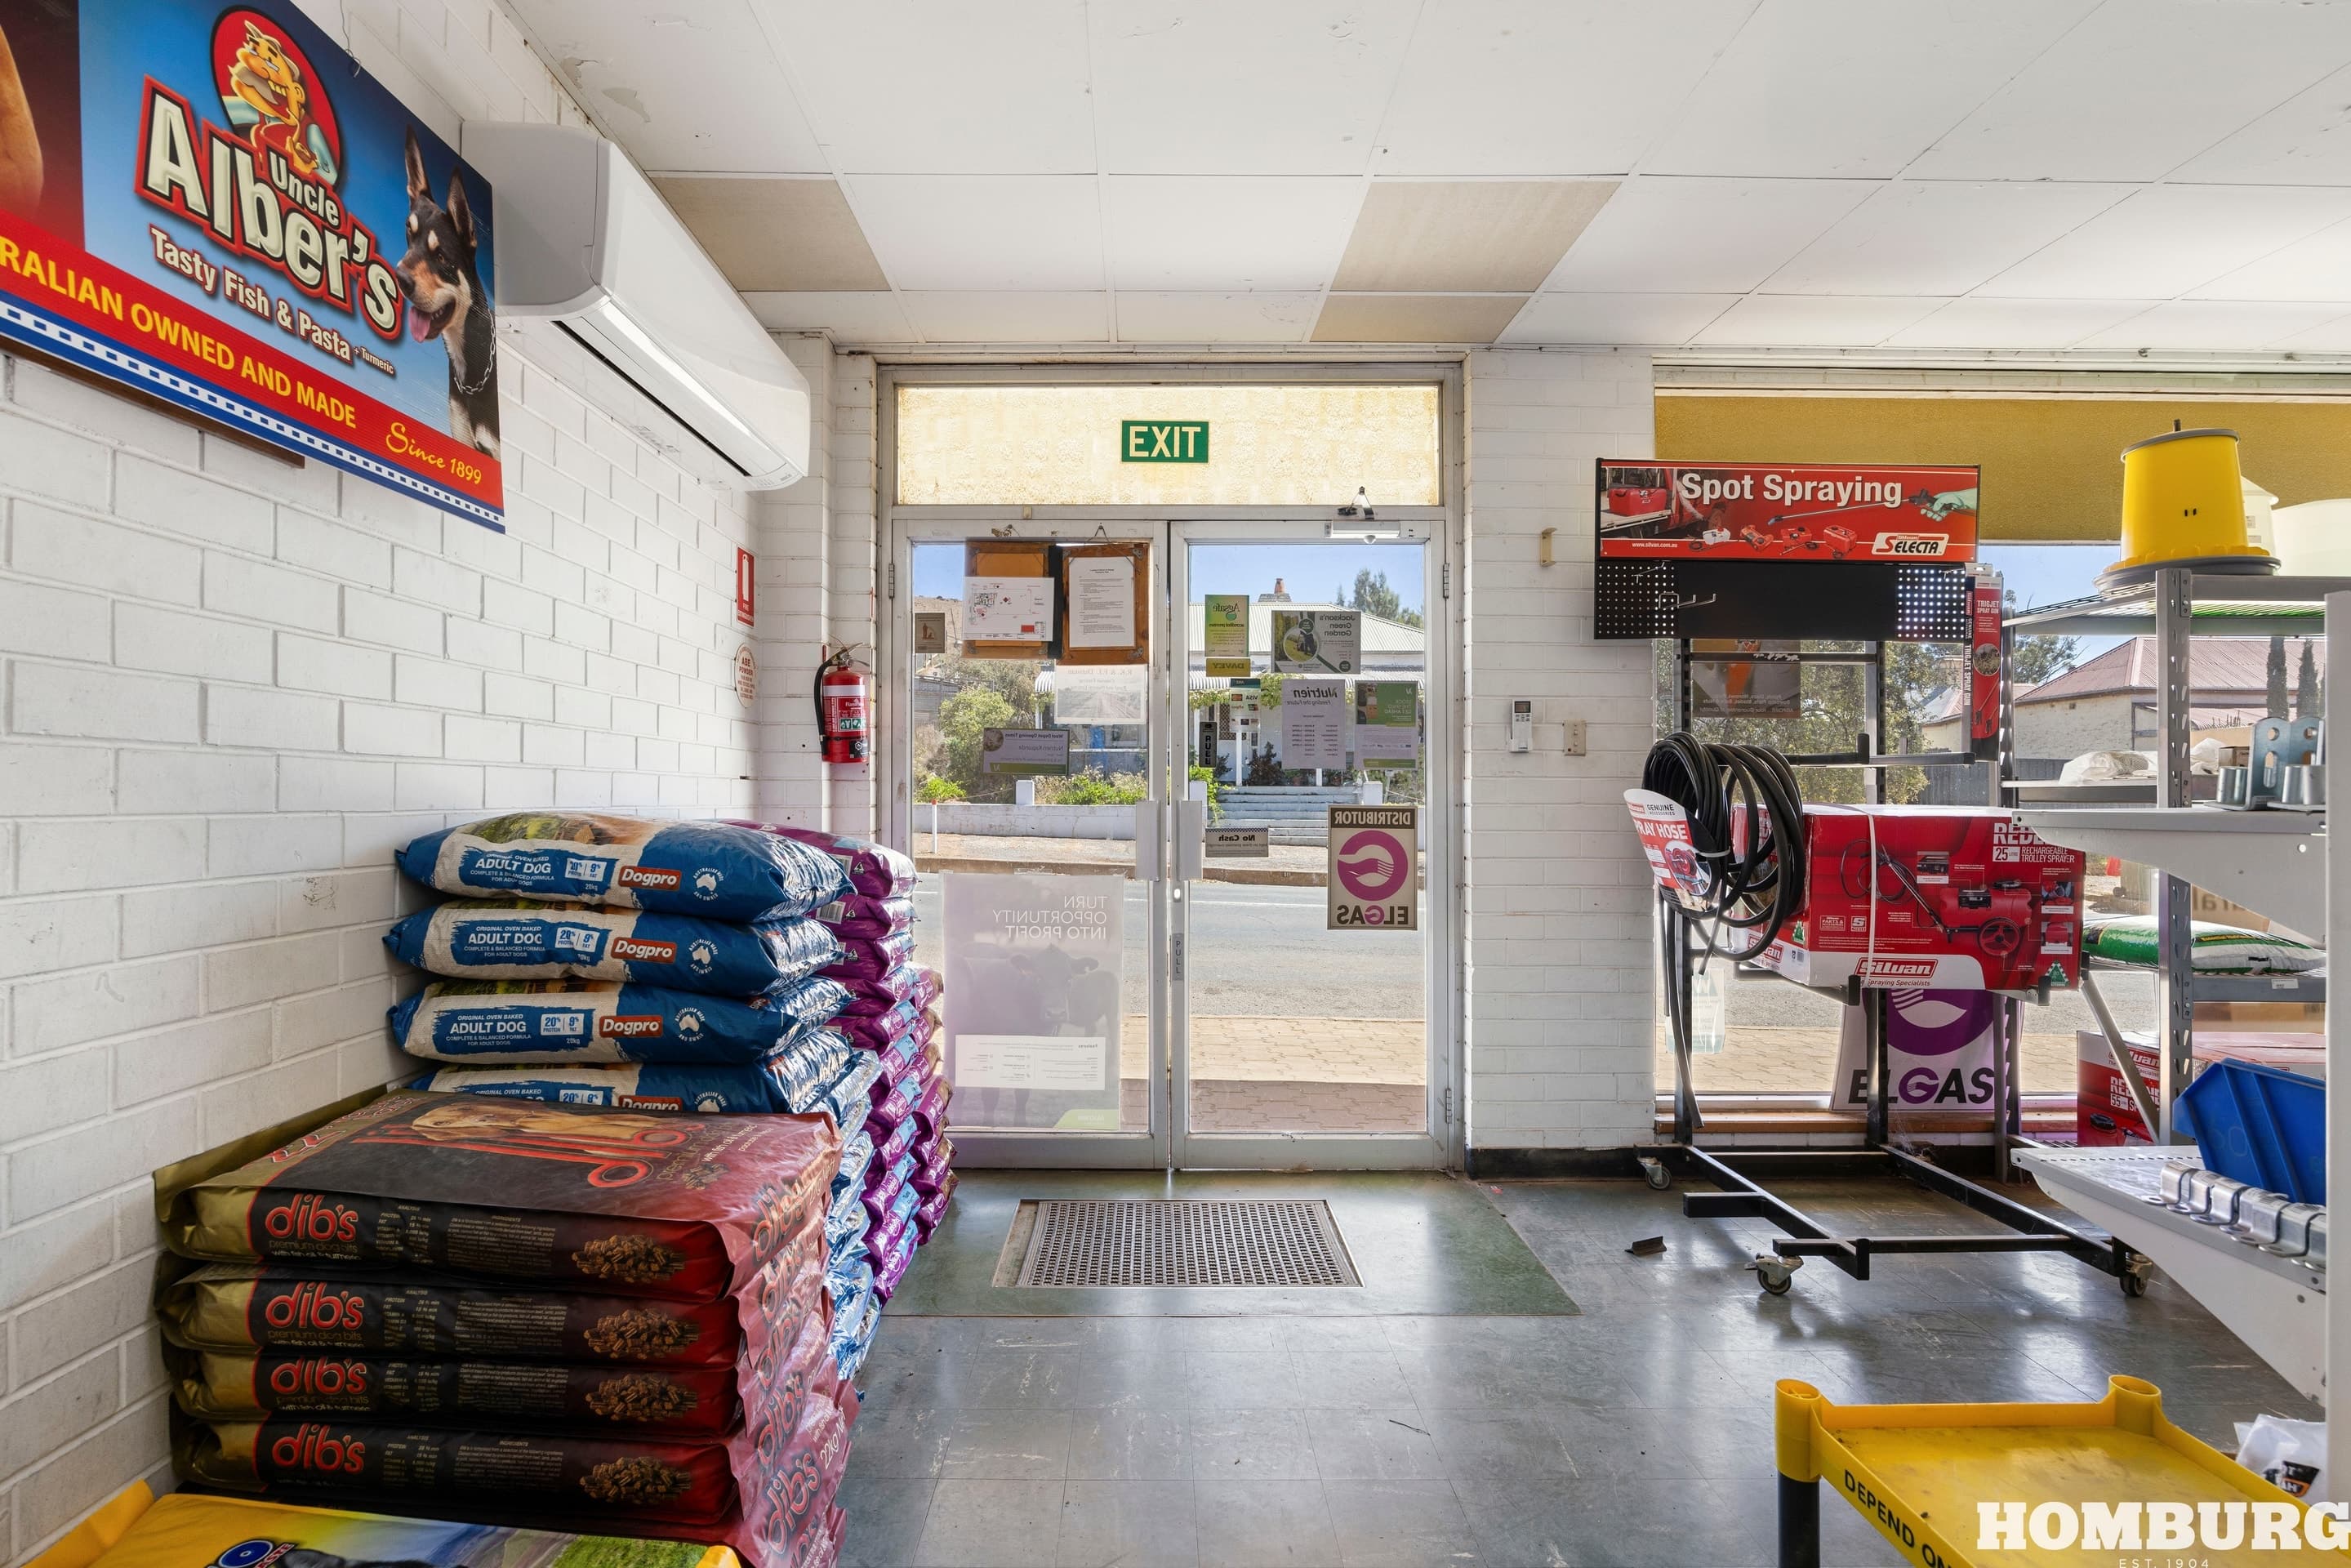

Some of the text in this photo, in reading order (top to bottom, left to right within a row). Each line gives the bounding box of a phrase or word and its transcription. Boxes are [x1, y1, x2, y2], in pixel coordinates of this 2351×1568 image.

[270, 149, 341, 226] Uncle
[145, 91, 399, 332] Alber's
[150, 226, 395, 376] Tasty Fish & Pasta Turmeric
[131, 302, 234, 371] OWNED
[241, 350, 291, 397] AND
[296, 386, 357, 430] MADE
[385, 422, 447, 470] Since
[450, 456, 483, 485] 1899
[1129, 425, 1202, 459] EXIT
[1682, 473, 1903, 508] Spot Spraying
[1875, 536, 1939, 554] SELECTA
[1634, 819, 1688, 840] PRAY HOSE
[475, 858, 552, 874] ADULT DOG
[1995, 848, 2009, 861] 25
[2021, 847, 2068, 855] RECHARGEABLE
[2021, 854, 2075, 863] TROLLEY SPRAYER
[622, 867, 677, 886] Dogpro
[468, 933, 511, 944] ADULT
[614, 940, 673, 959] Dogpro
[450, 1022, 527, 1034] ADULT DOG
[602, 1018, 660, 1036] Dogpro
[2112, 1095, 2121, 1107] 55
[265, 1193, 358, 1242] dib's
[265, 1282, 365, 1330] dib's
[271, 1356, 367, 1395] dib's
[272, 1423, 366, 1474] dib's
[820, 1434, 840, 1470] 22kg
[768, 1452, 822, 1555] dib's
[1845, 1469, 1915, 1548] DEPEND
